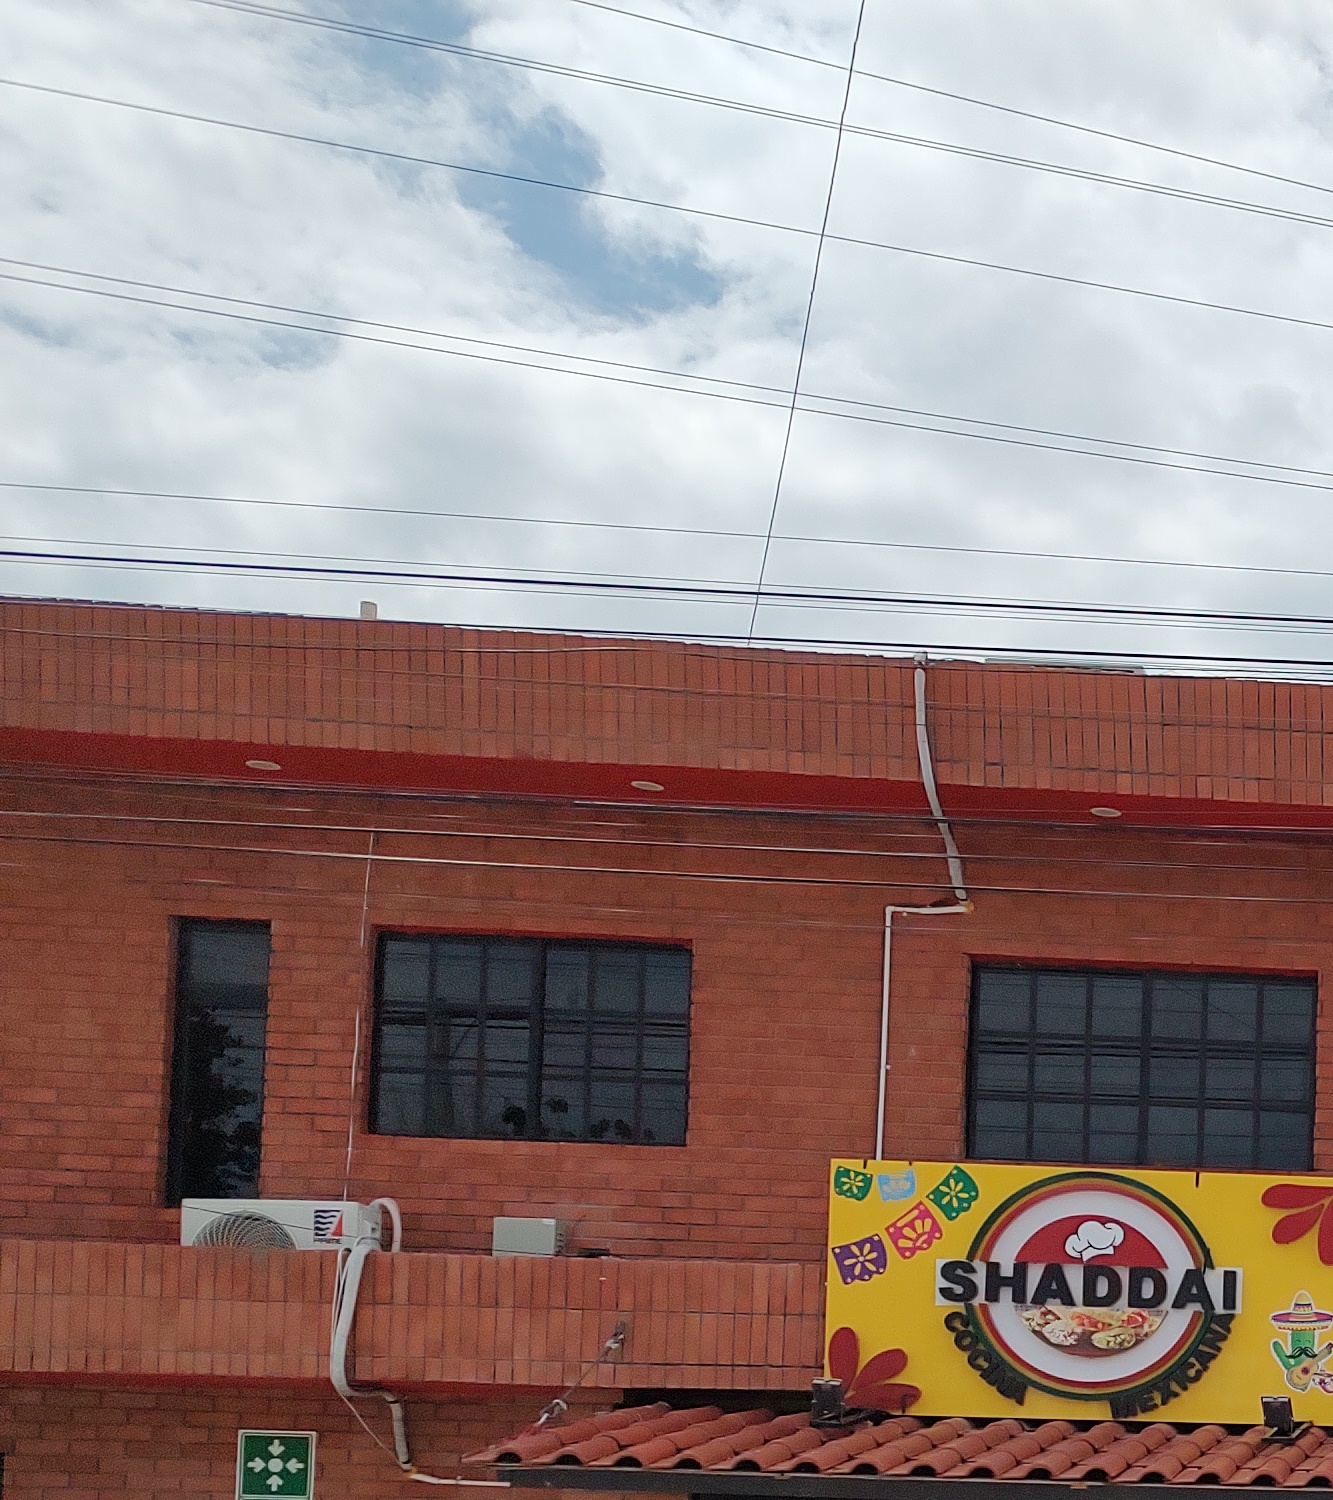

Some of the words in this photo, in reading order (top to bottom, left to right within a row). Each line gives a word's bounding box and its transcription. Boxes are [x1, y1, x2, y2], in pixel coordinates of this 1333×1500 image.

[938, 1260, 1238, 1311] SHADDAI
[943, 1311, 1028, 1407] COCINA
[1109, 1313, 1237, 1419] MEXICANA
